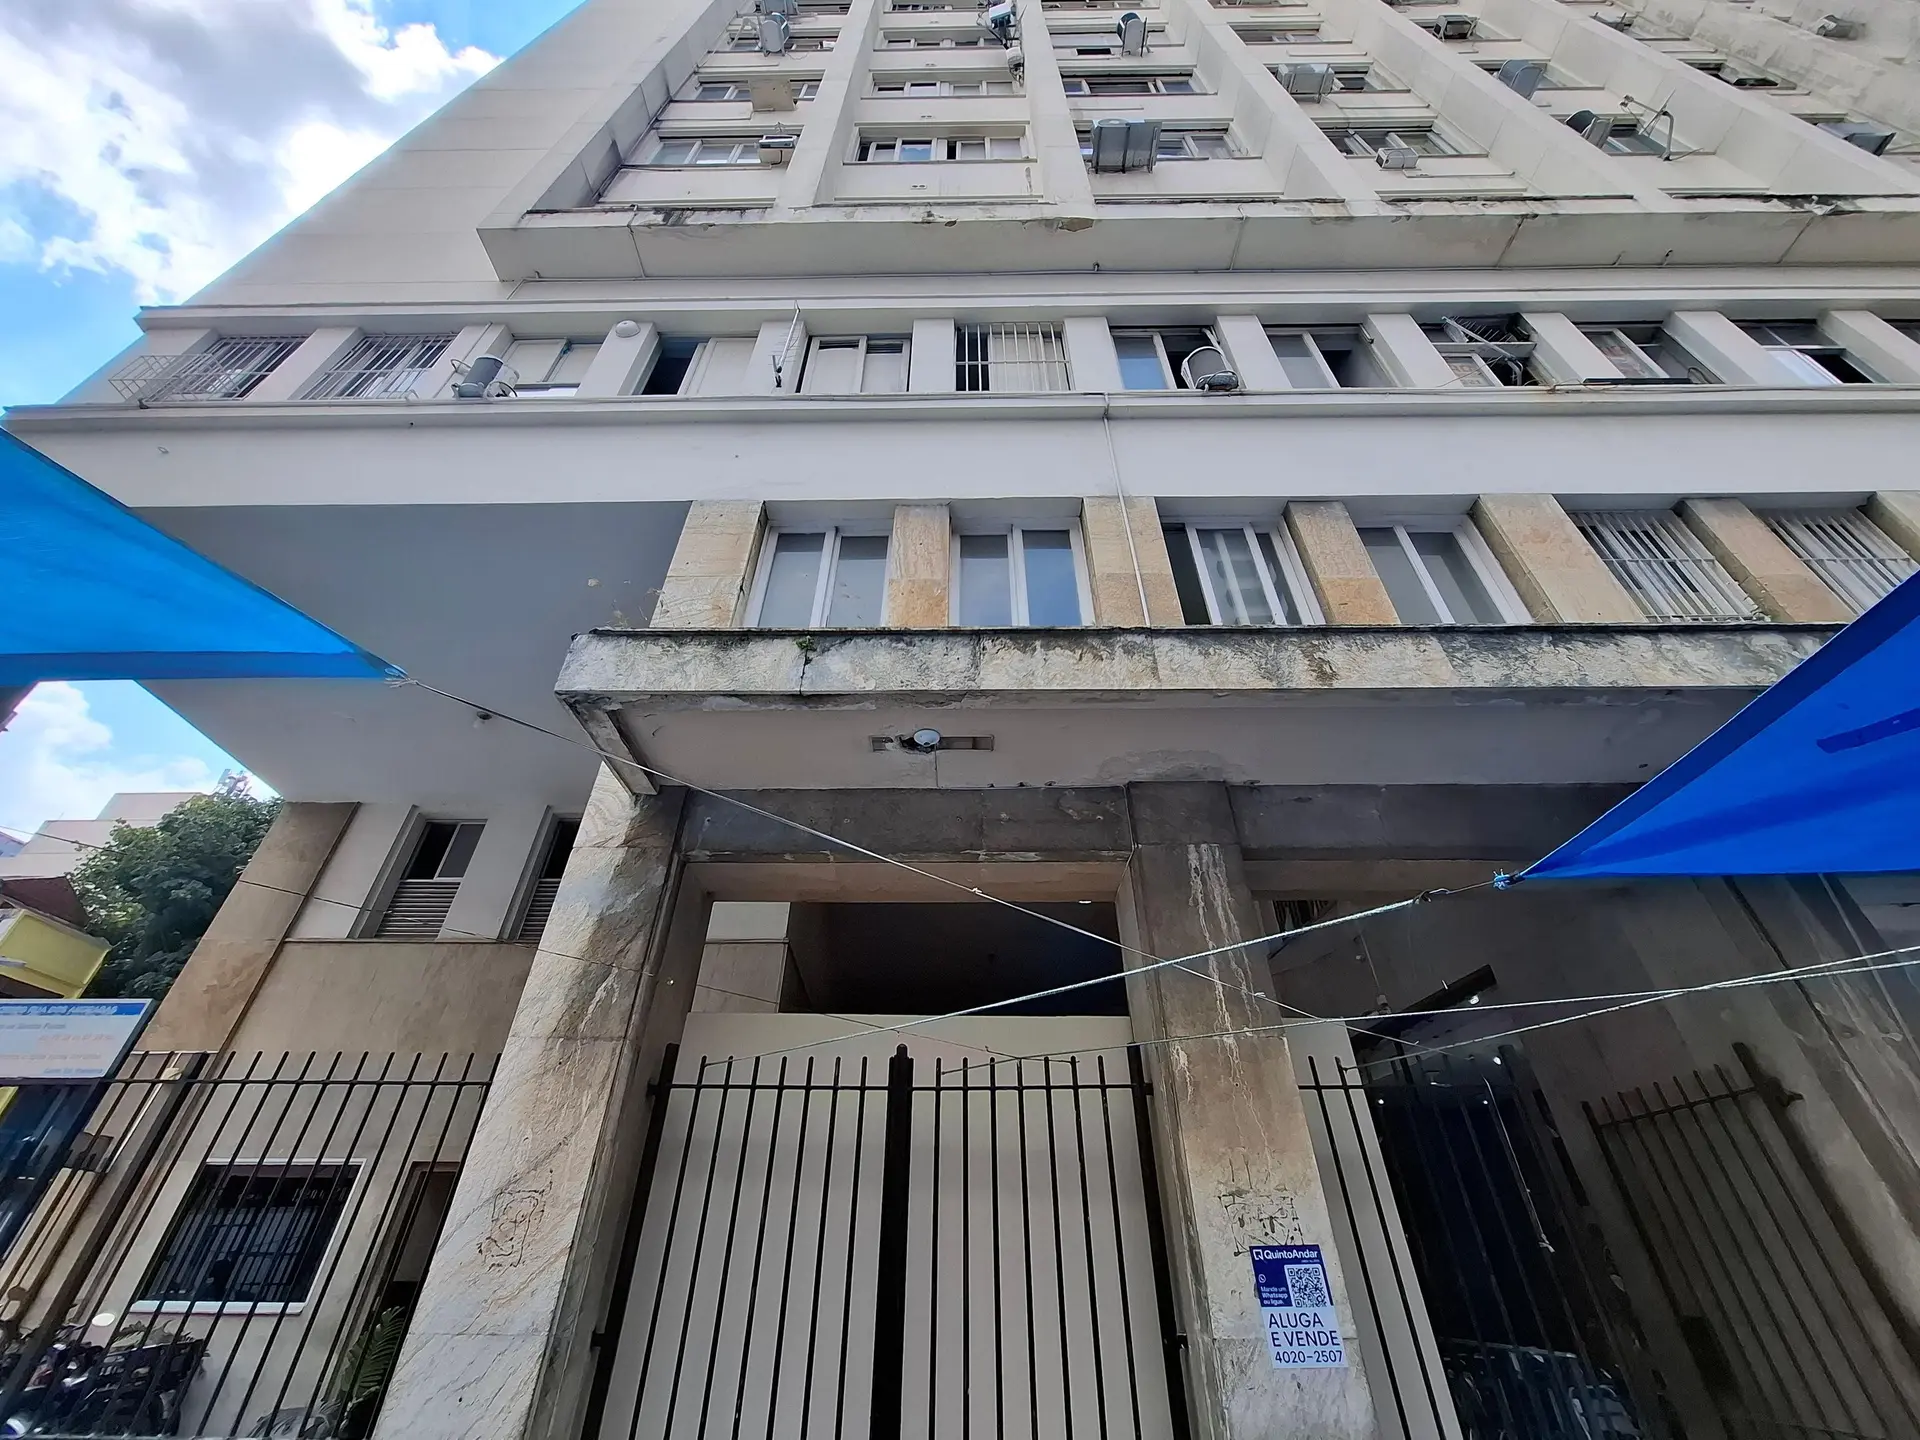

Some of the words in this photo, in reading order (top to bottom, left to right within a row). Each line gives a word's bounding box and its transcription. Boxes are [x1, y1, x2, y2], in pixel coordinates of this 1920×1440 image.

[1263, 1249, 1318, 1259] QuintoAndar
[1269, 1312, 1324, 1328] ALUGA
[1271, 1331, 1282, 1347] E
[1283, 1330, 1341, 1347] VENDE
[1275, 1350, 1342, 1363] 4020-2507
